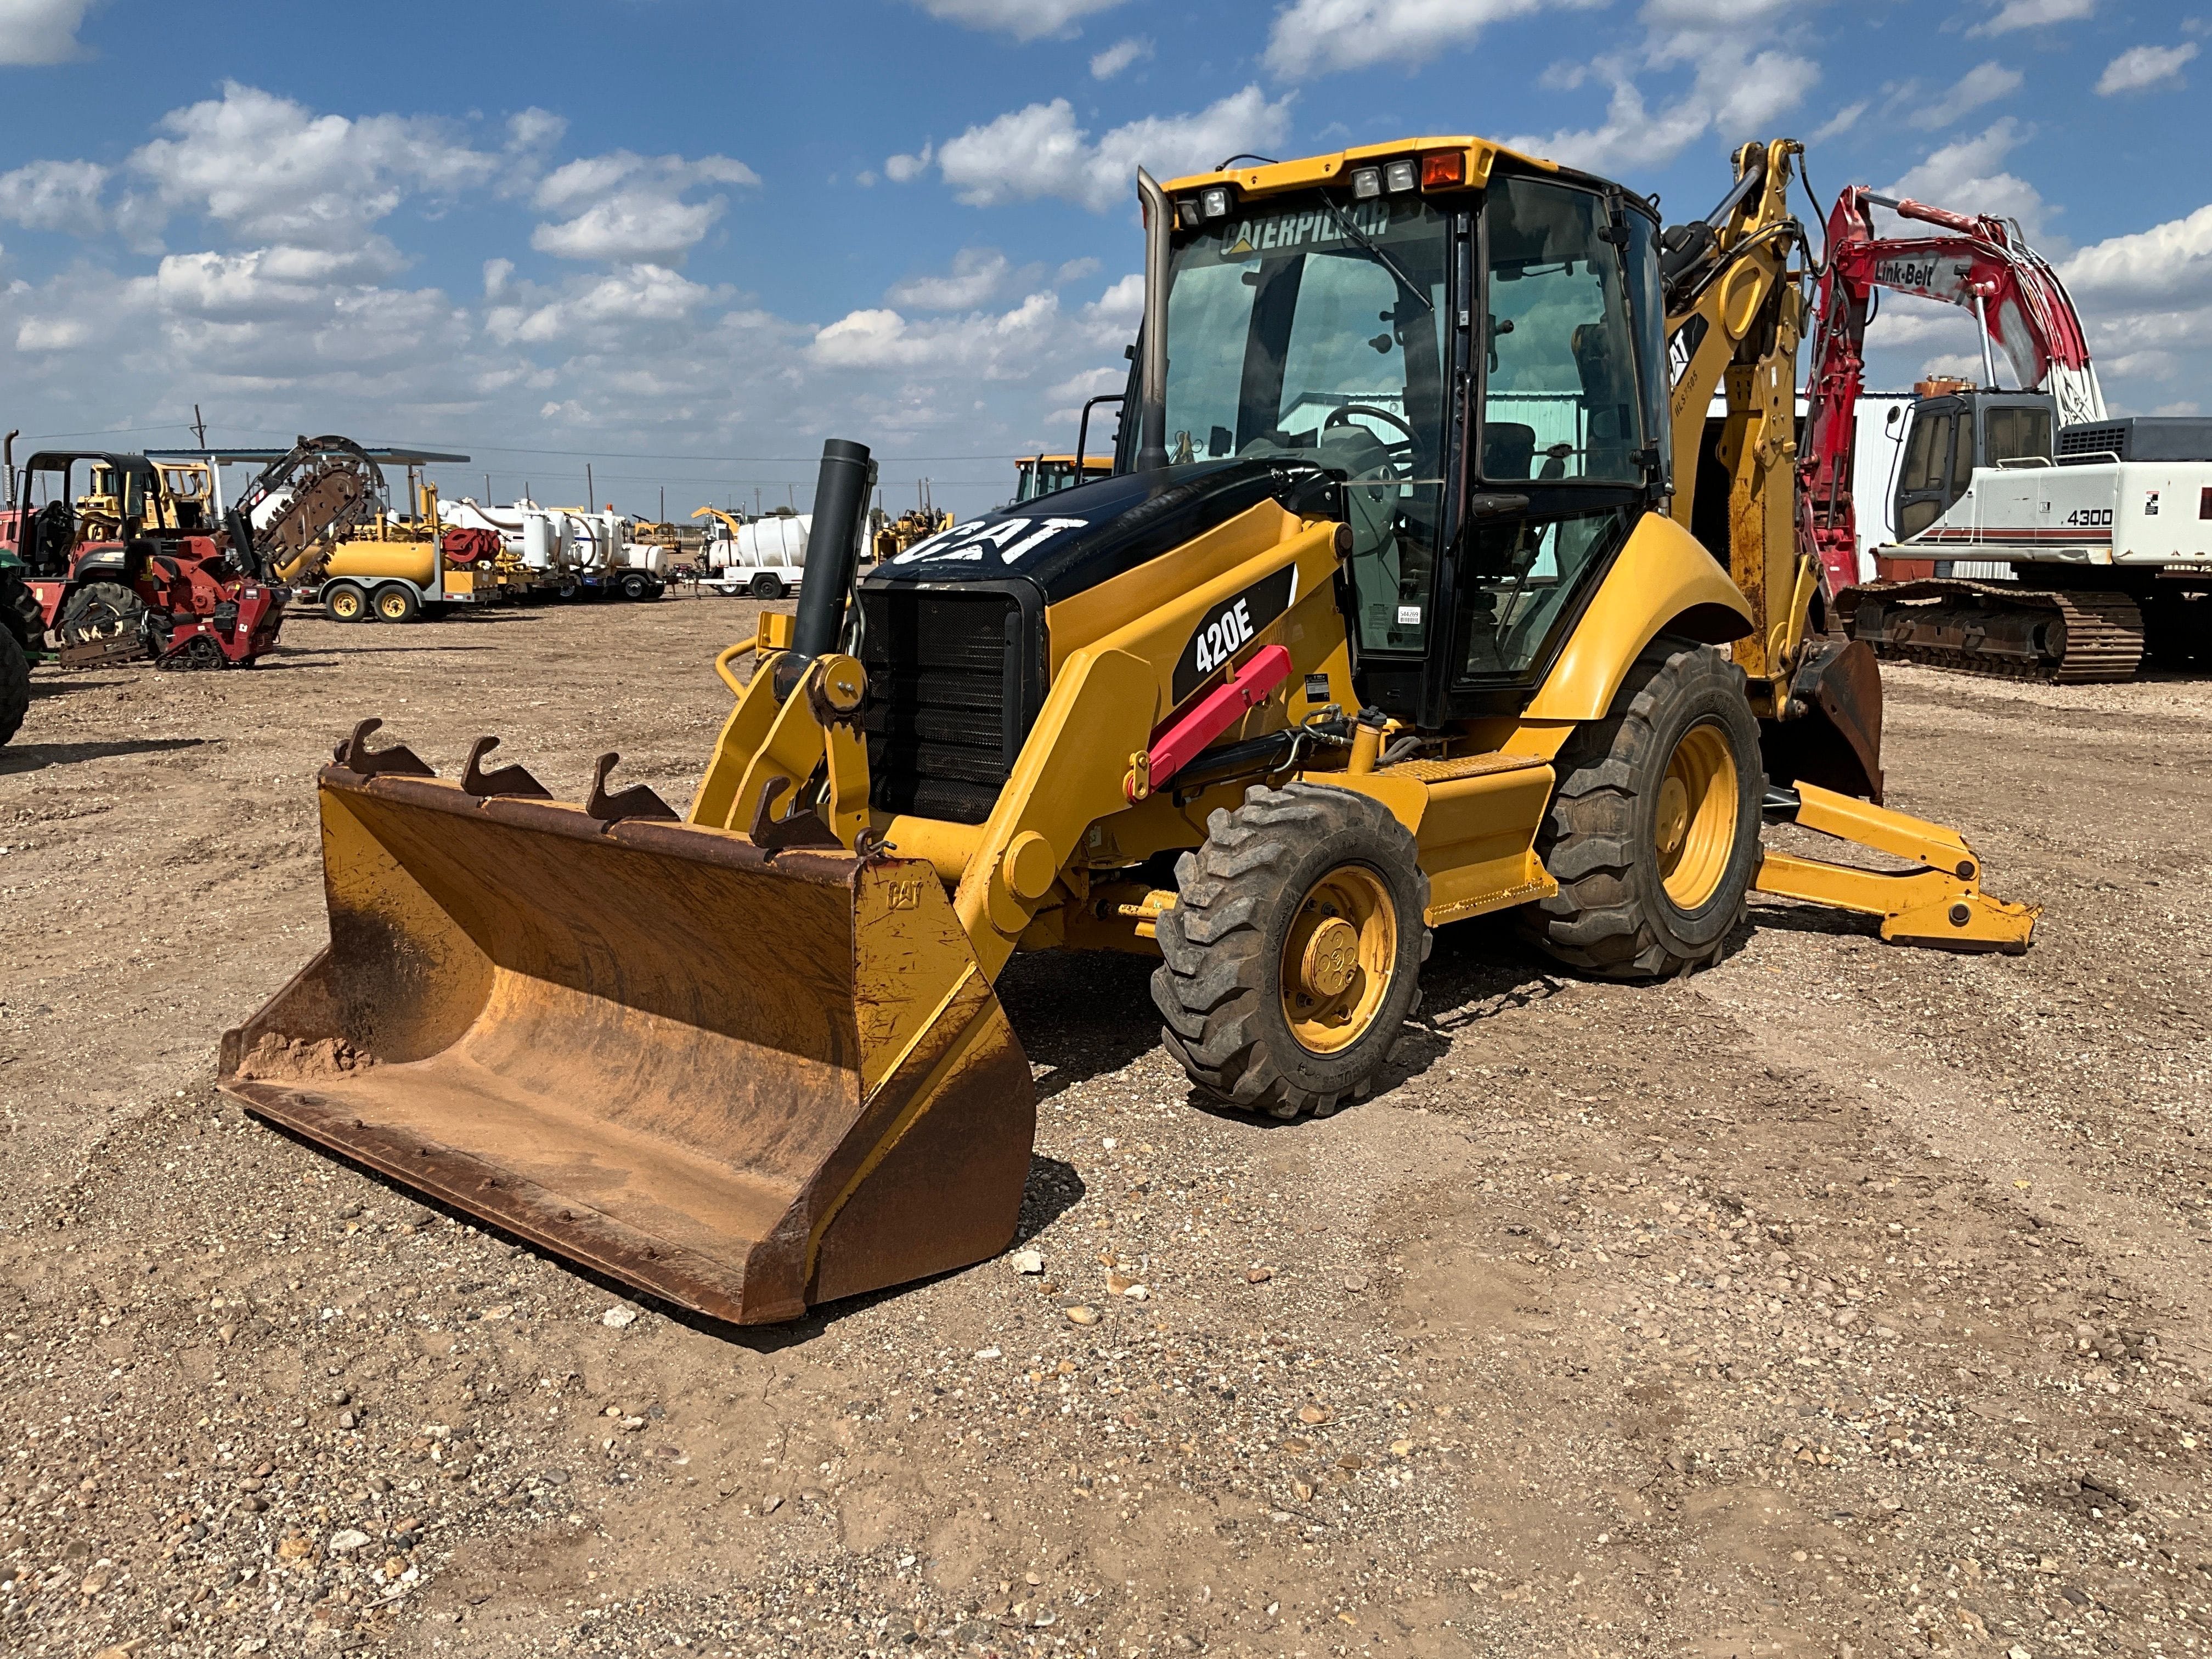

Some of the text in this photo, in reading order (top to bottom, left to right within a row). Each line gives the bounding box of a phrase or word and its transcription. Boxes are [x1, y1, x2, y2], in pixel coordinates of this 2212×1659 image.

[1874, 259, 1933, 286] Link-Belt
[1669, 329, 1689, 391] AT
[2067, 509, 2113, 526] 4300
[893, 518, 1089, 565] CAT
[1196, 597, 1254, 673] 420E
[887, 881, 923, 910] CAT
